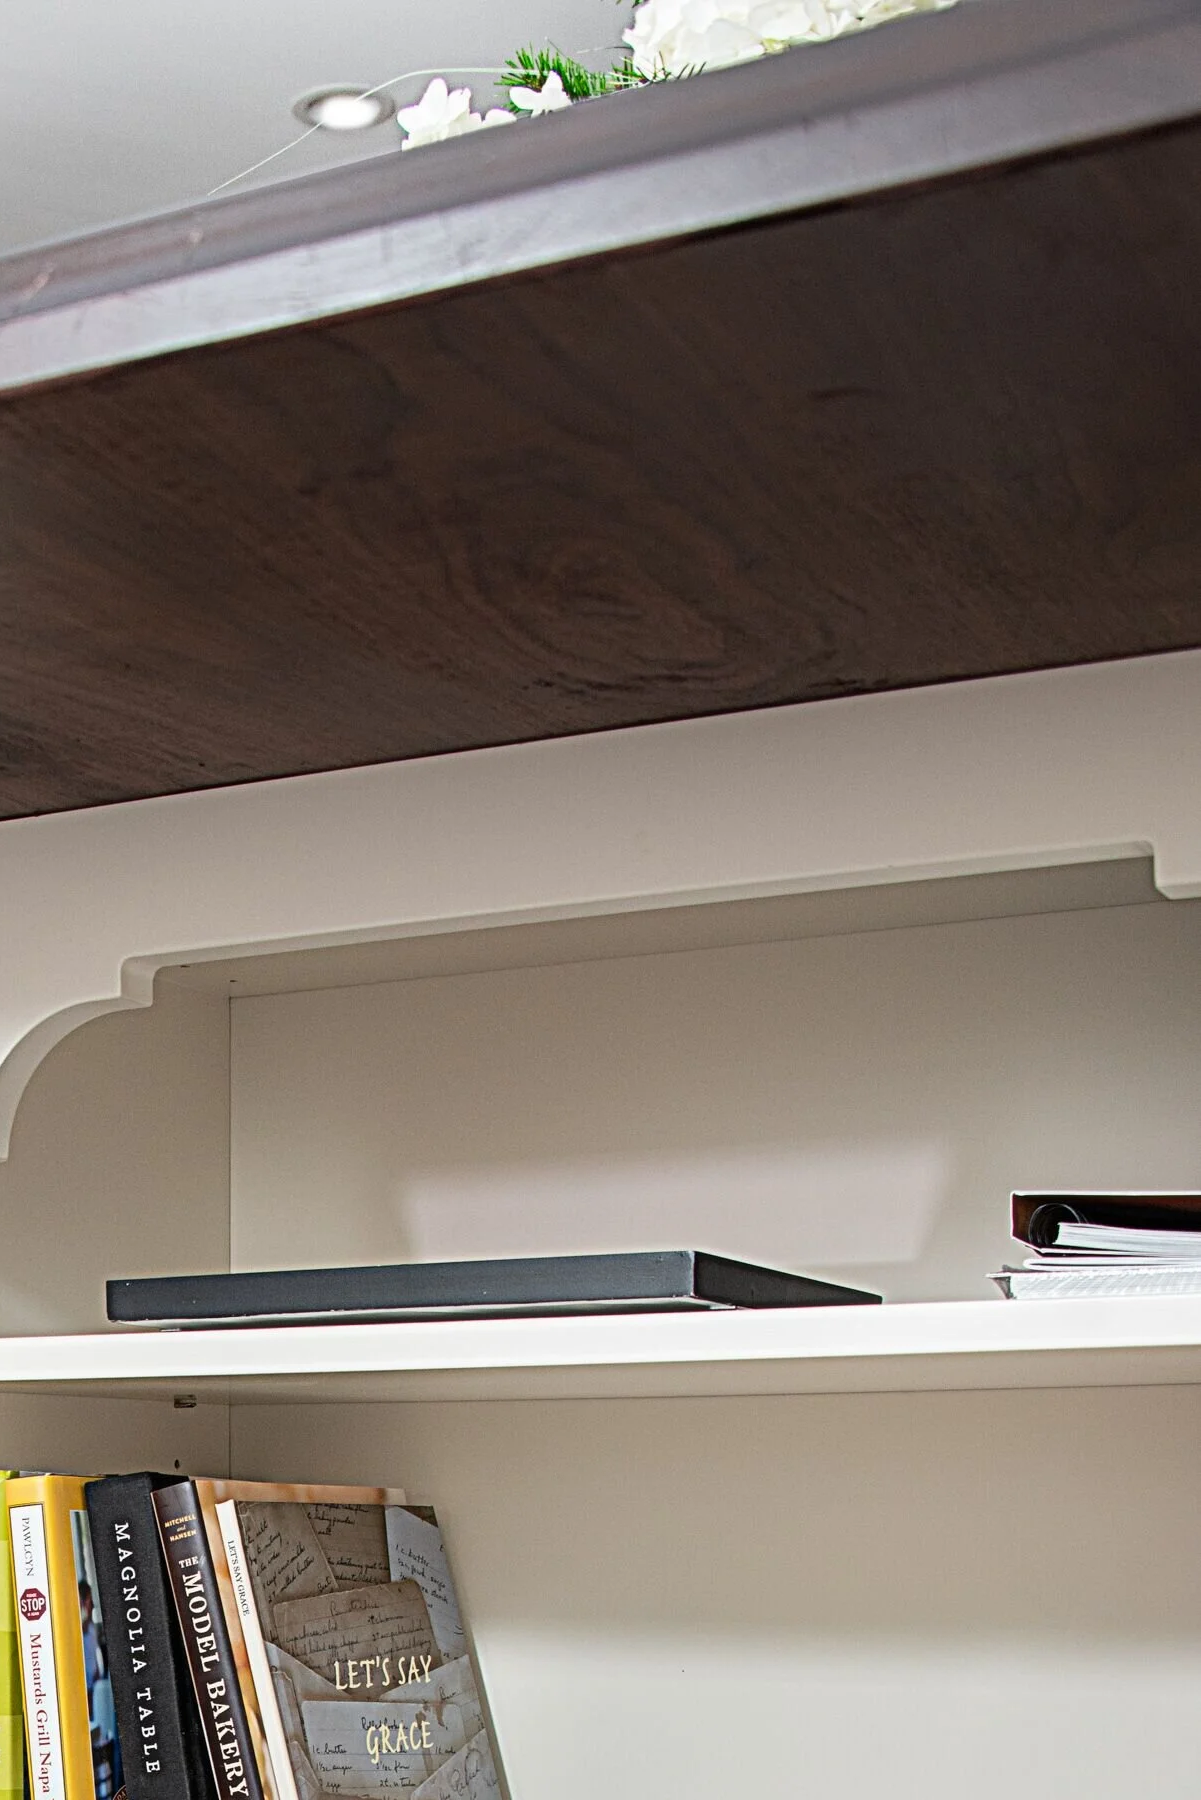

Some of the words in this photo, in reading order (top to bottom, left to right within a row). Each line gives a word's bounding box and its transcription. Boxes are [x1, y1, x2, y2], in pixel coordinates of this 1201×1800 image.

[164, 1514, 196, 1528] MITCHELL
[169, 1530, 196, 1542] HANSEN
[21, 1517, 34, 1577] PAWLCYN
[178, 1556, 198, 1568] THE
[21, 1597, 45, 1612] STOP
[233, 1566, 243, 1582] SAY
[238, 1584, 250, 1616] GRACE
[114, 1521, 146, 1675] MAGNOLIA
[136, 1687, 160, 1773] TABLE
[30, 1634, 47, 1704] Mustards
[182, 1570, 220, 1673] MODEL
[206, 1677, 249, 1797] BAKERY
[333, 1656, 391, 1690] LET'S
[398, 1654, 432, 1685] SAY
[37, 1708, 51, 1747] Grill
[366, 1720, 434, 1764] GRACE
[39, 1752, 51, 1793] Napa
